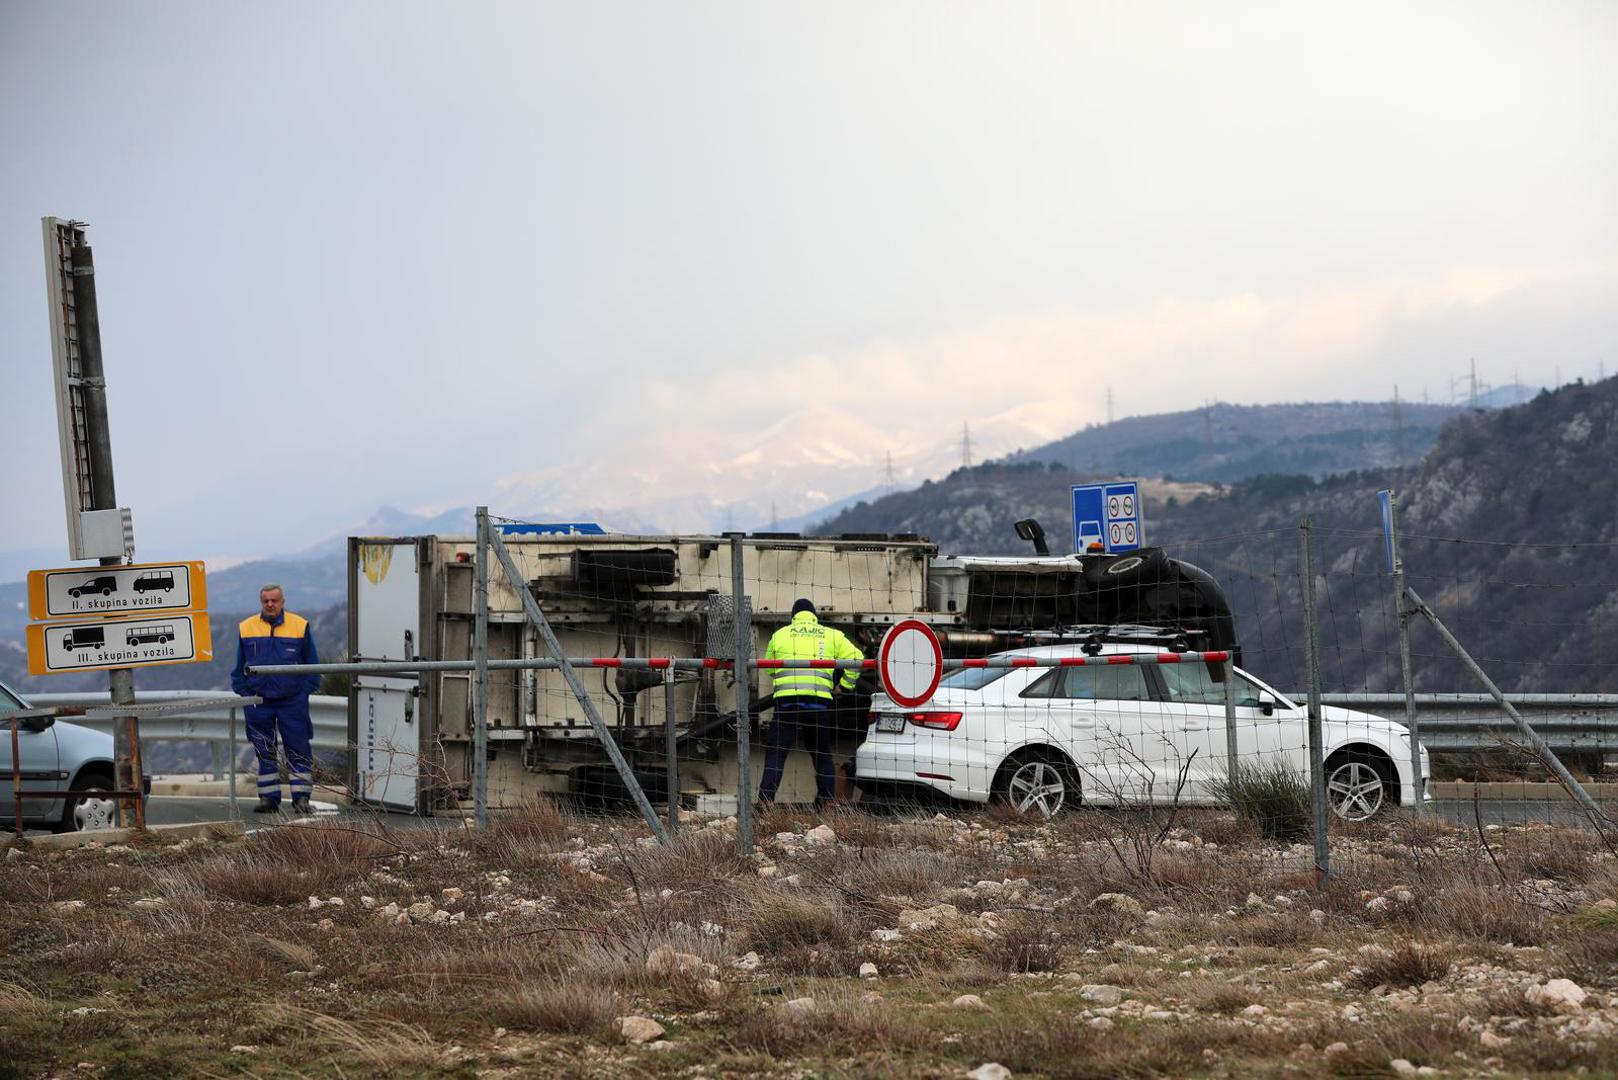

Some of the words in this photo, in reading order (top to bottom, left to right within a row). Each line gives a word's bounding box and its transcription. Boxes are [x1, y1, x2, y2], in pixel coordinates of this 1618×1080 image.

[72, 600, 83, 610] II.
[88, 598, 128, 609] skupina
[132, 596, 163, 606] vozila
[78, 653, 93, 663] III.
[98, 651, 138, 662] skupina
[143, 647, 175, 657] vozila
